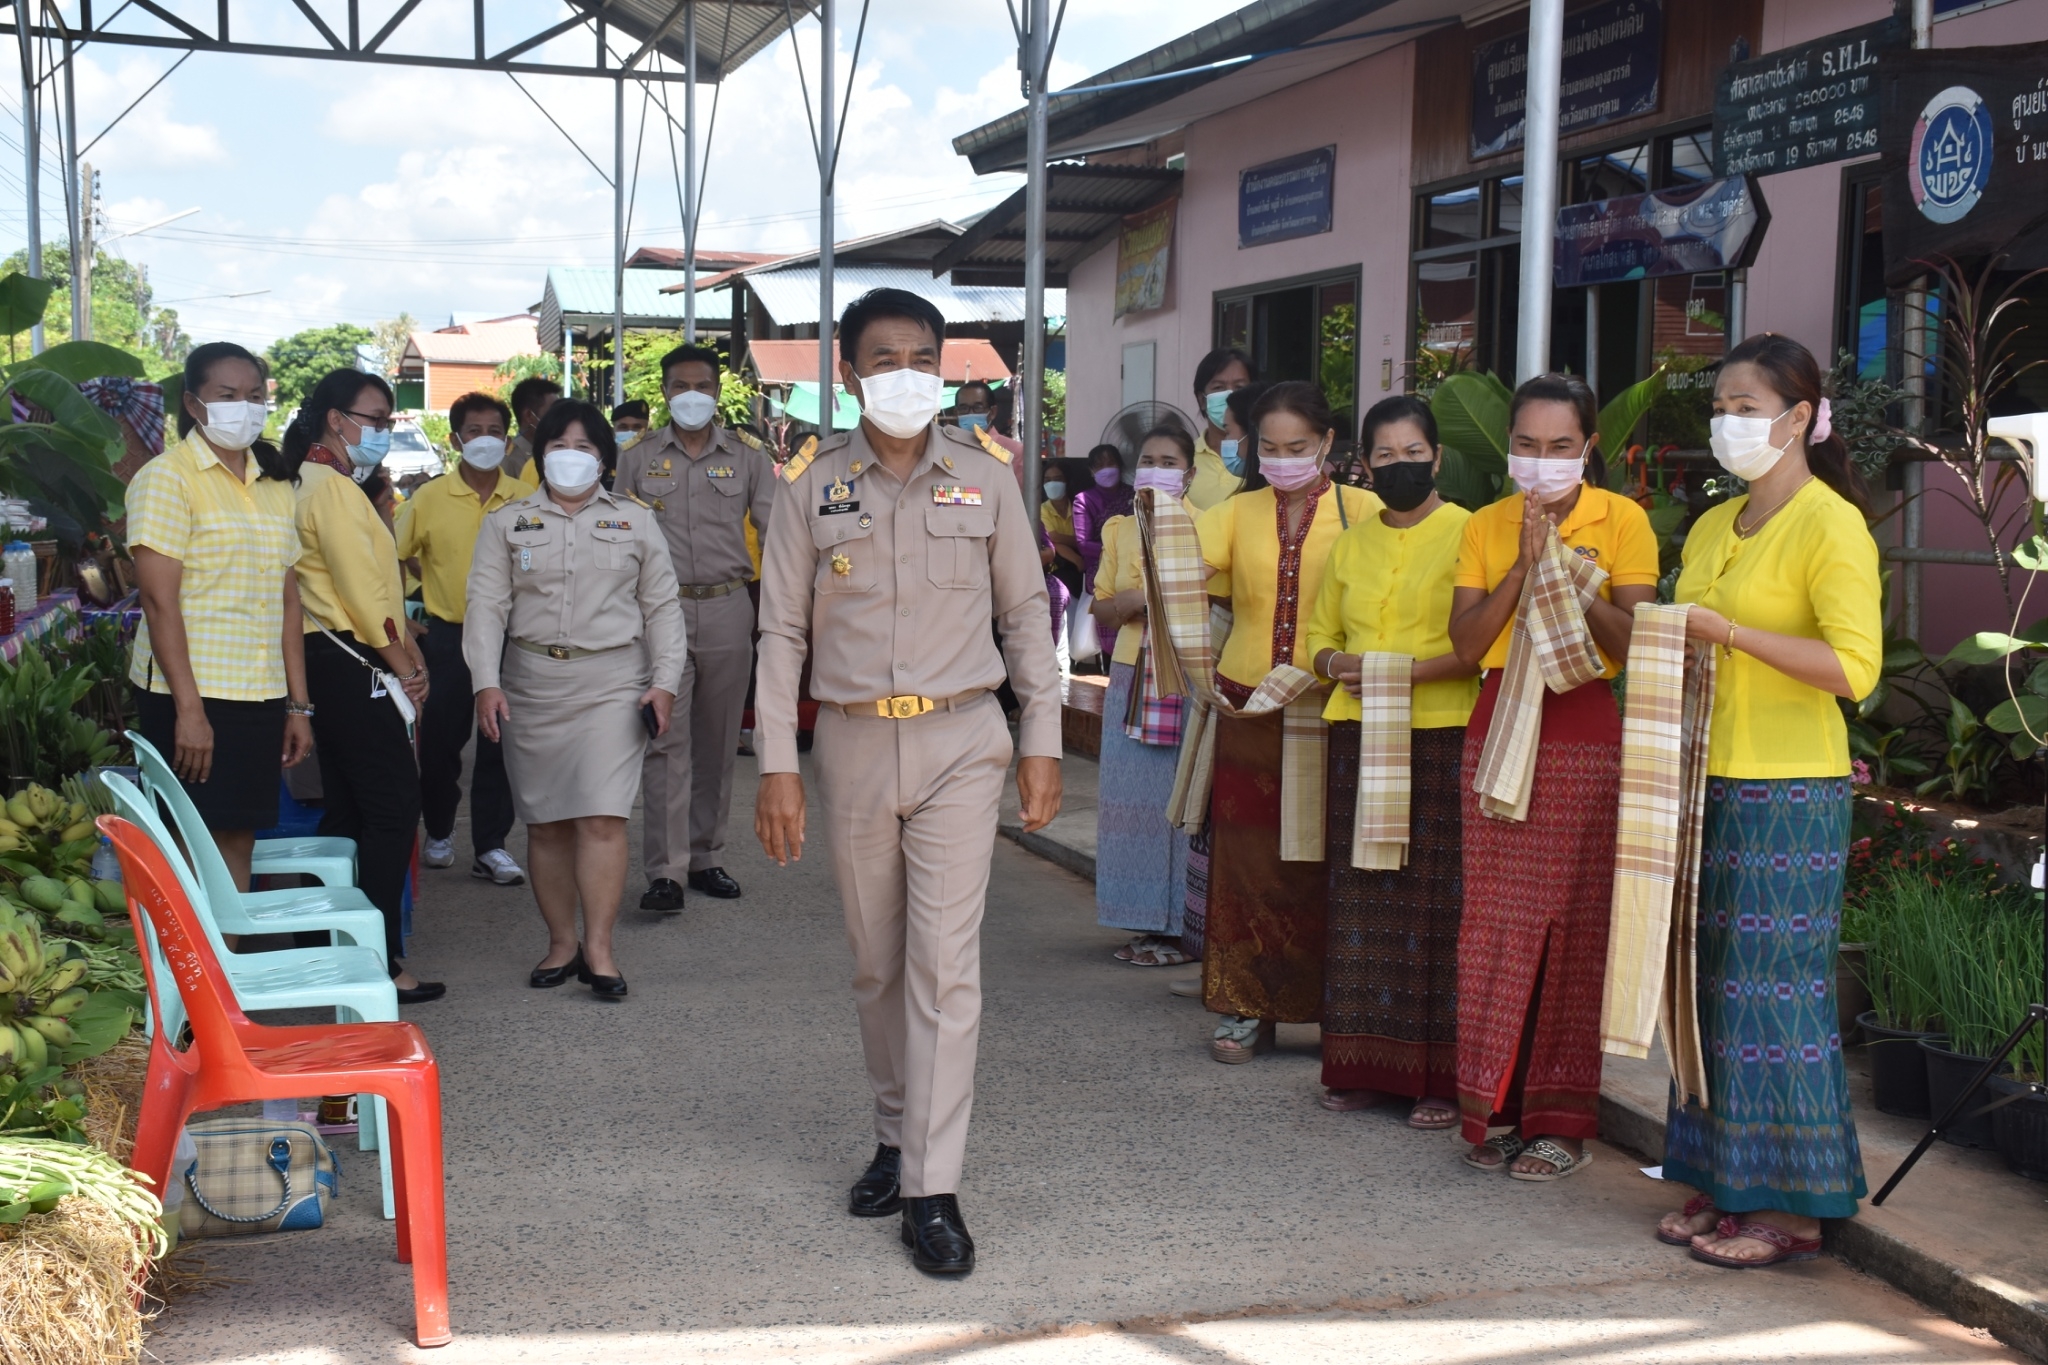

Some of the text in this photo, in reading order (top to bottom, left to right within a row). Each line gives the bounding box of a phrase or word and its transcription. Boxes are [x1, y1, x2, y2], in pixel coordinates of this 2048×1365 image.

[1822, 39, 1878, 76] S.M.L.
[1795, 82, 1847, 109] 250,000
[1850, 76, 1870, 94] บาท
[2012, 77, 2048, 131] ศูนย์เ
[1786, 144, 1799, 166] 19
